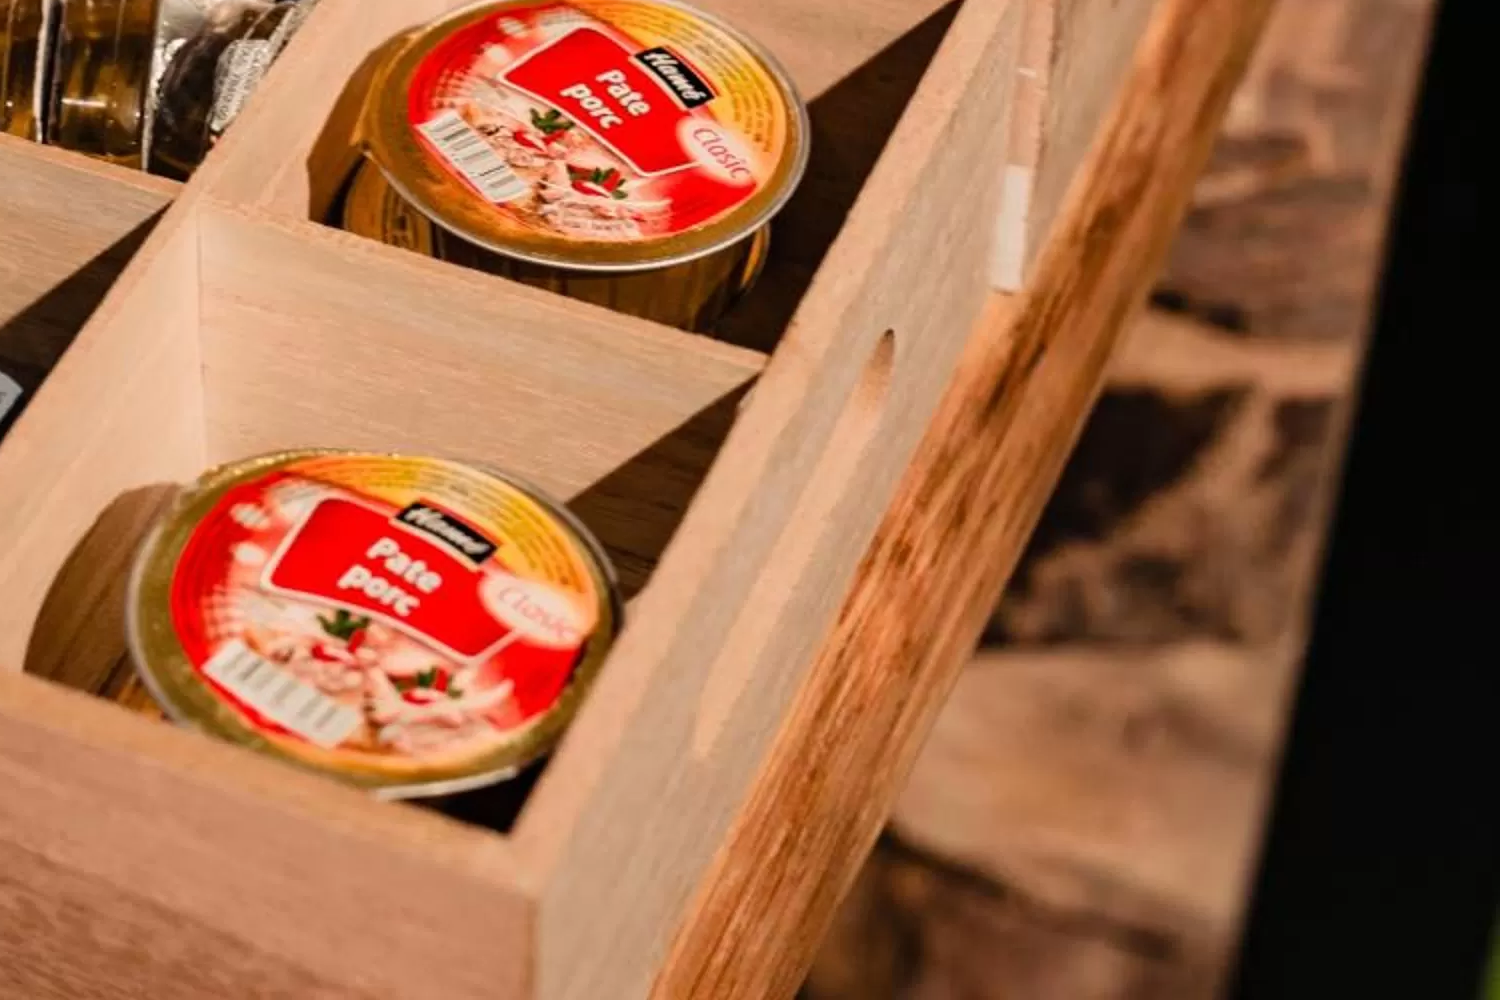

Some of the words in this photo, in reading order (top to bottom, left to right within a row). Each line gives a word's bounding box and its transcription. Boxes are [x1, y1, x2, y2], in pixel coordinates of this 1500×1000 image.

[559, 83, 623, 129] porc
[595, 69, 650, 116] Pate
[692, 127, 751, 179] Clasic
[366, 536, 443, 594] Pate
